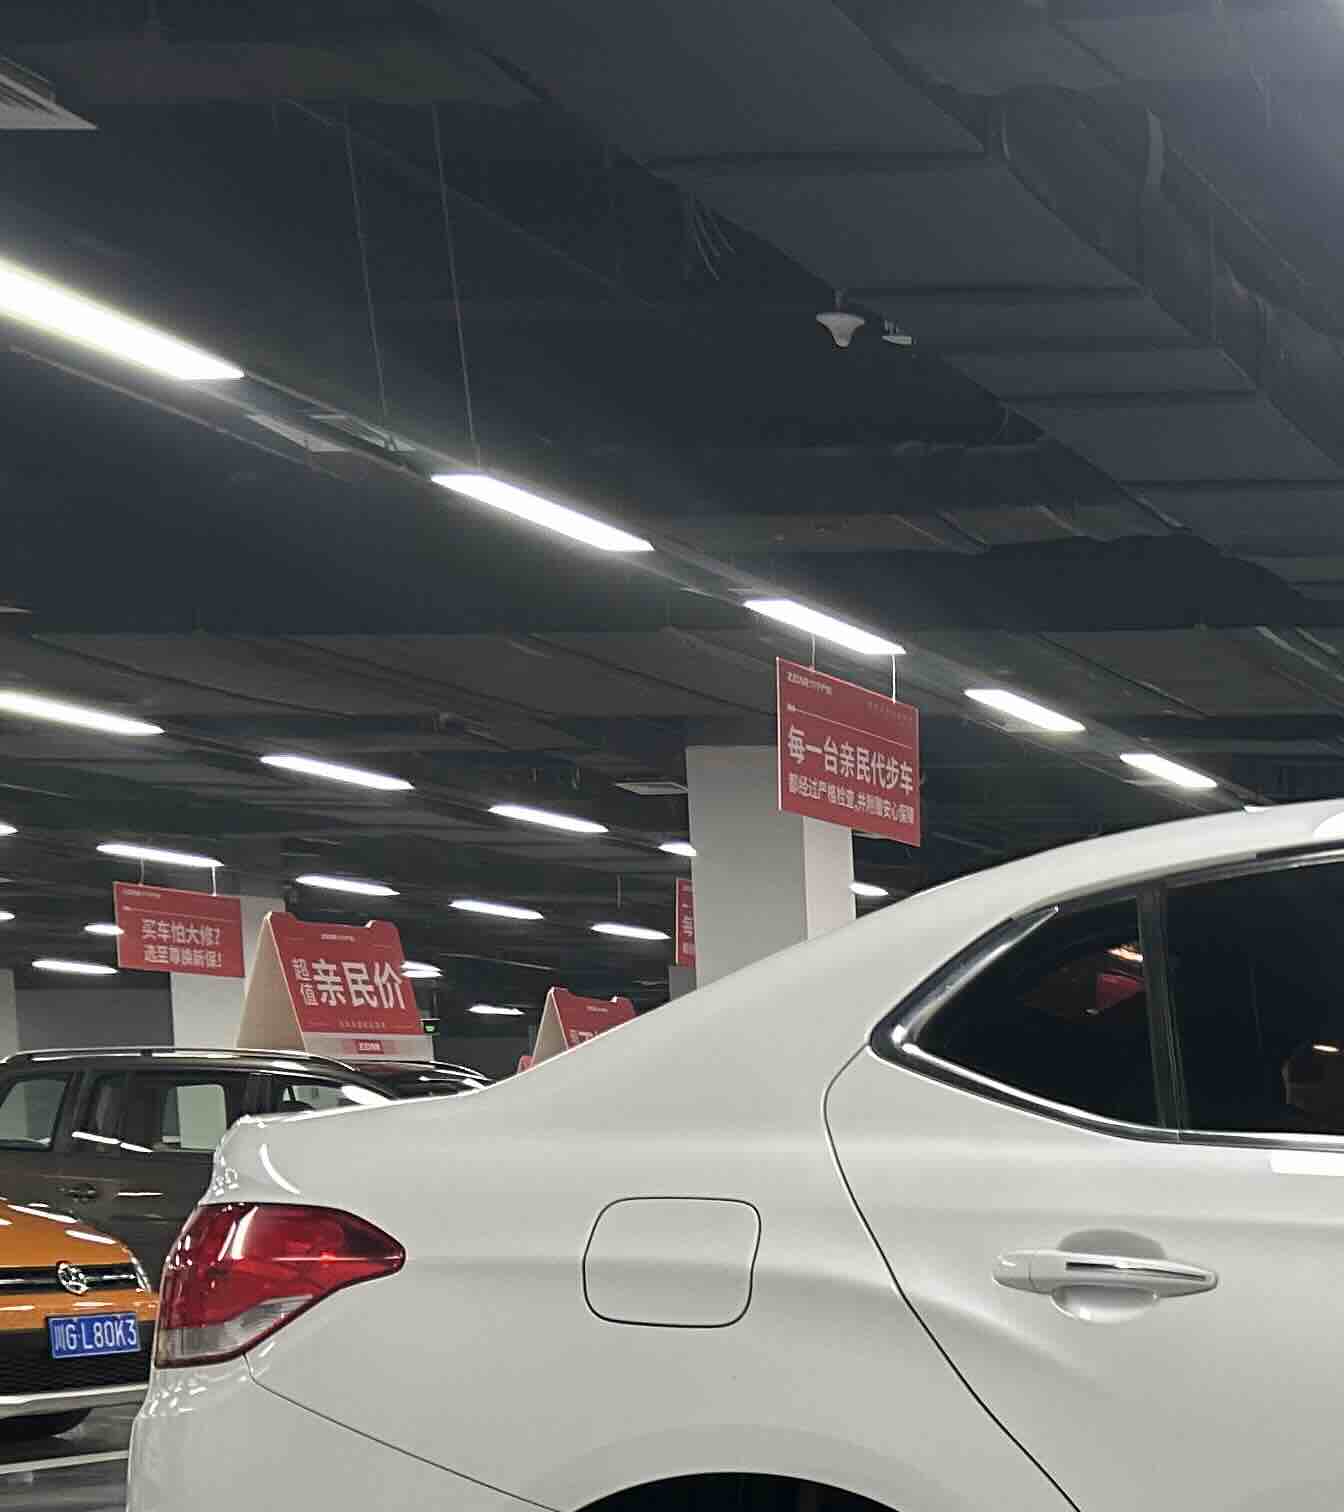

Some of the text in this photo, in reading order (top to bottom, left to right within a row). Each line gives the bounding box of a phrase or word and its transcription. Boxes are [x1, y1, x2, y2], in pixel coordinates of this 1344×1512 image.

[786, 724, 914, 797] 每一台亲民代步车
[311, 957, 407, 1010] 亲民价
